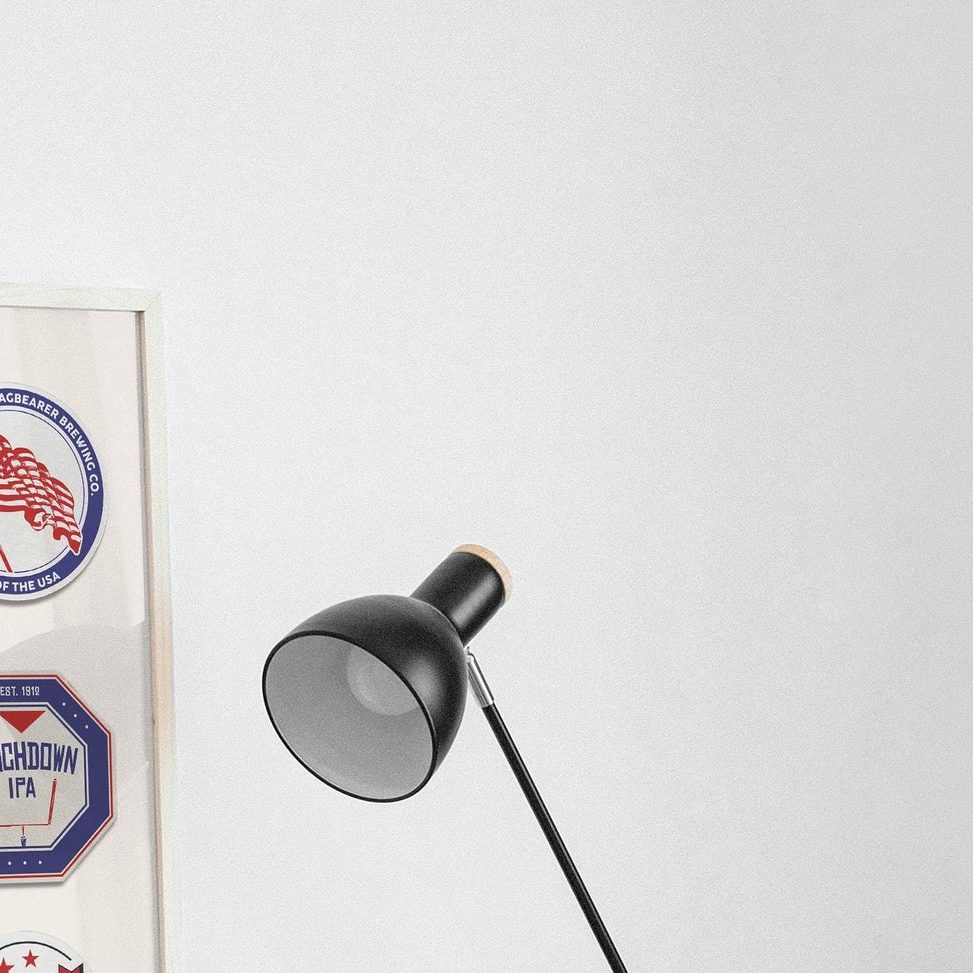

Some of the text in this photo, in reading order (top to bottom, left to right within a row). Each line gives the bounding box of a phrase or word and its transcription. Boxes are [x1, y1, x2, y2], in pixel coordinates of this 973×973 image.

[59, 416, 95, 471] BREWING
[90, 474, 99, 496] CO.
[12, 580, 35, 592] THE
[37, 572, 61, 588] USA
[0, 686, 39, 696] EST. 1912
[8, 777, 36, 799] IPA
